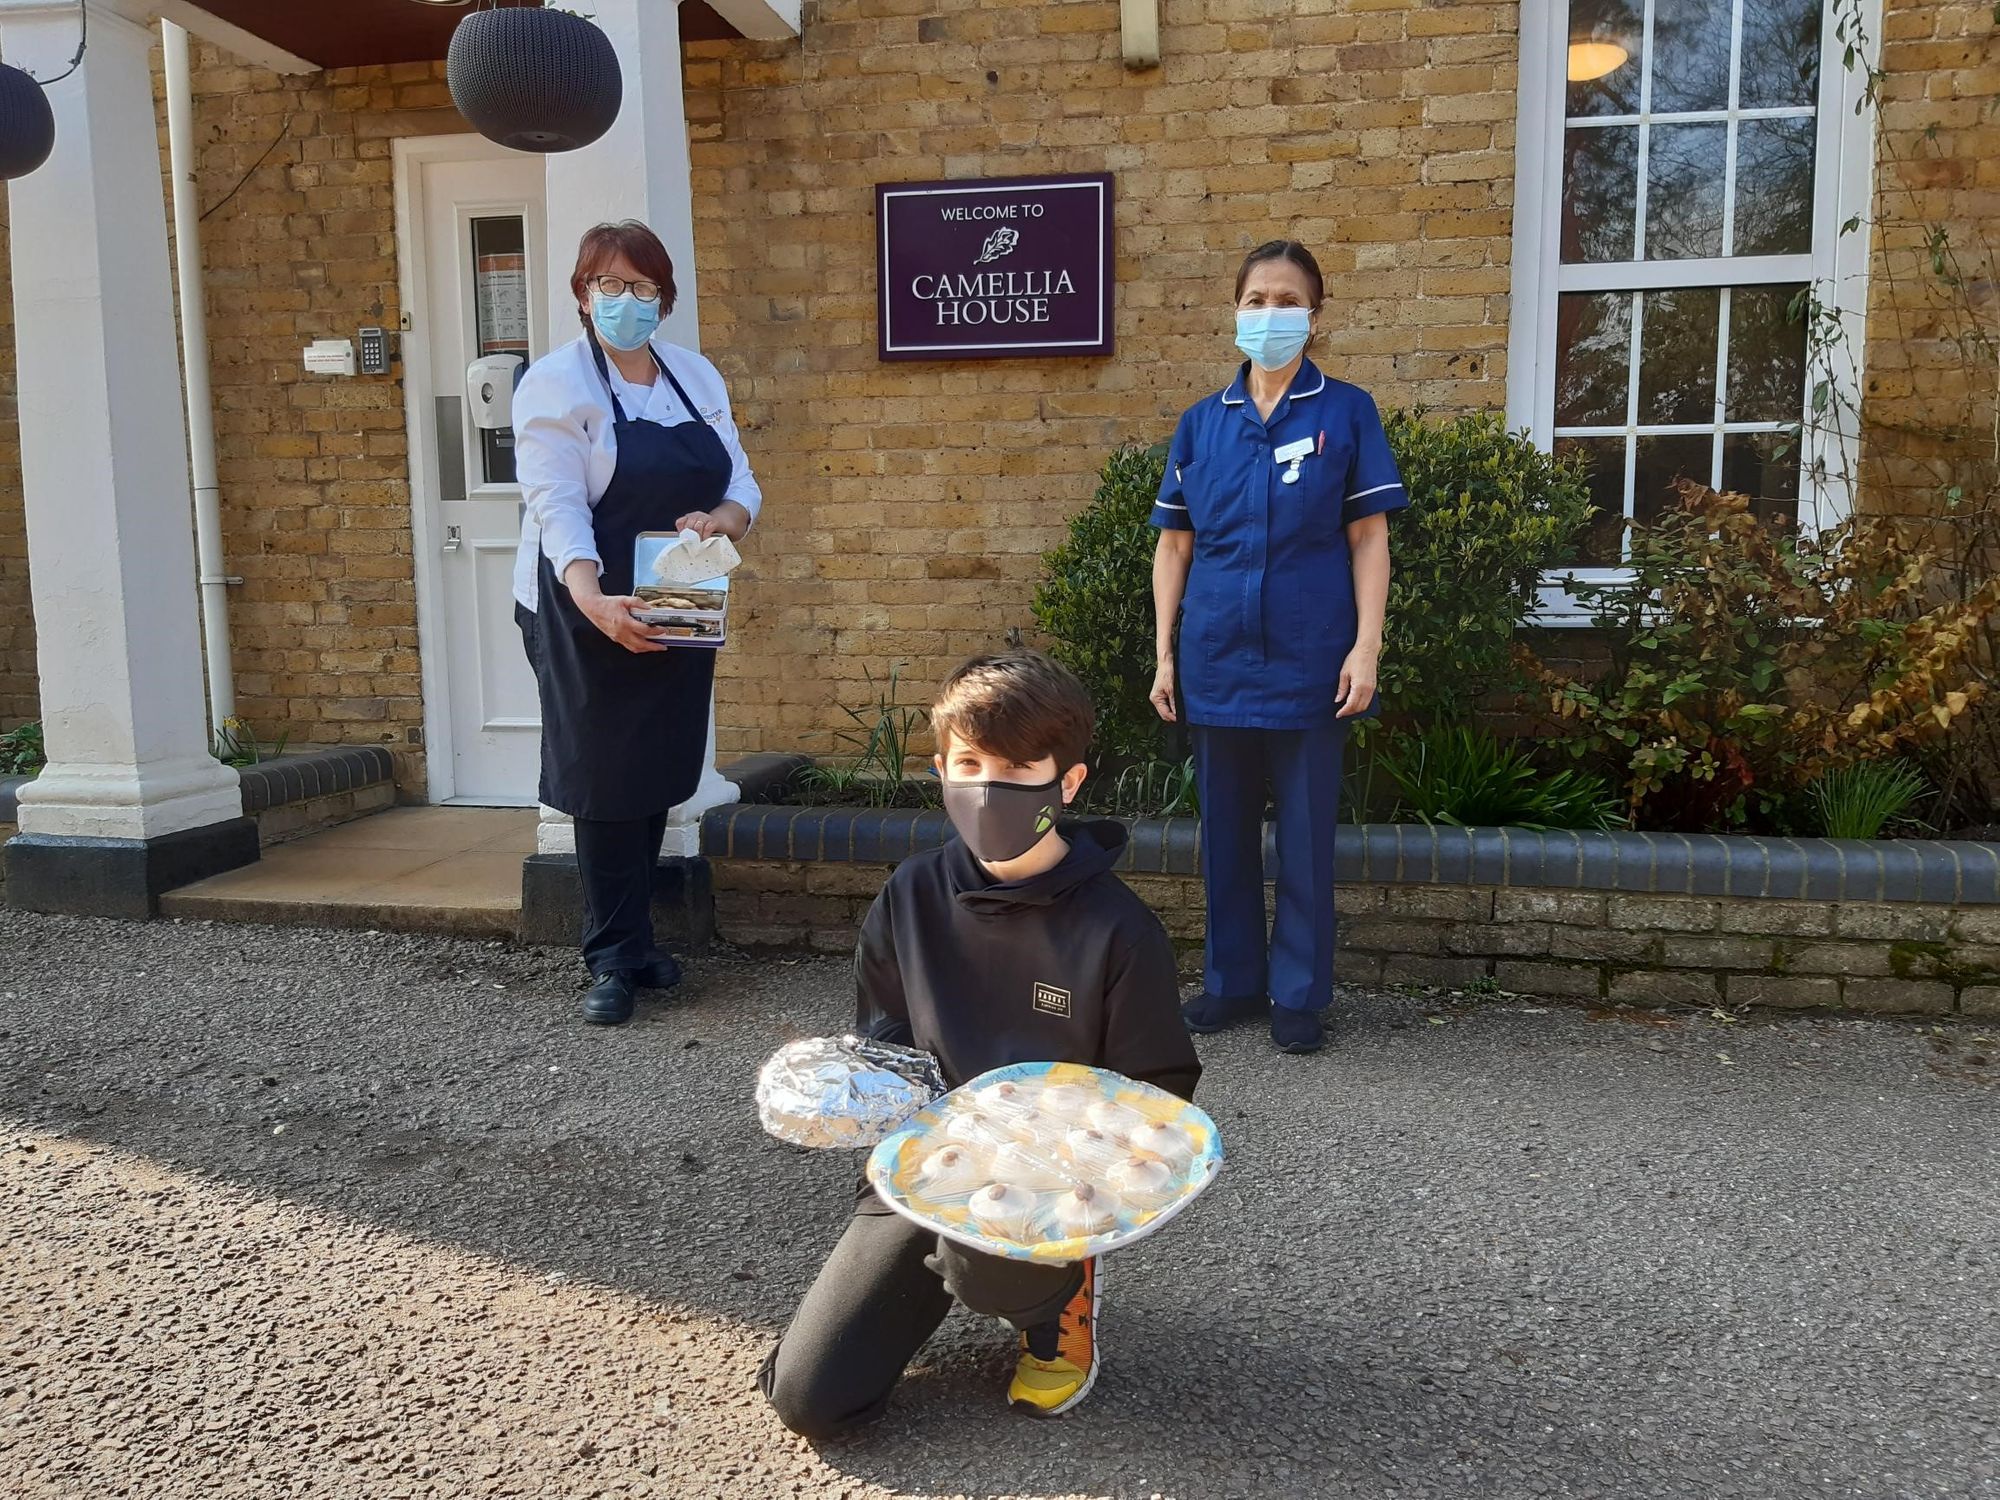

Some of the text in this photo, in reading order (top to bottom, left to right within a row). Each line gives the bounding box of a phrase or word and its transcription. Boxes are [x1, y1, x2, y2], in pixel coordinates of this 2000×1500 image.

[941, 203, 1044, 221] WELCOME TO
[911, 269, 1076, 300] CAMELLIA
[936, 298, 1050, 325] HOUSE
